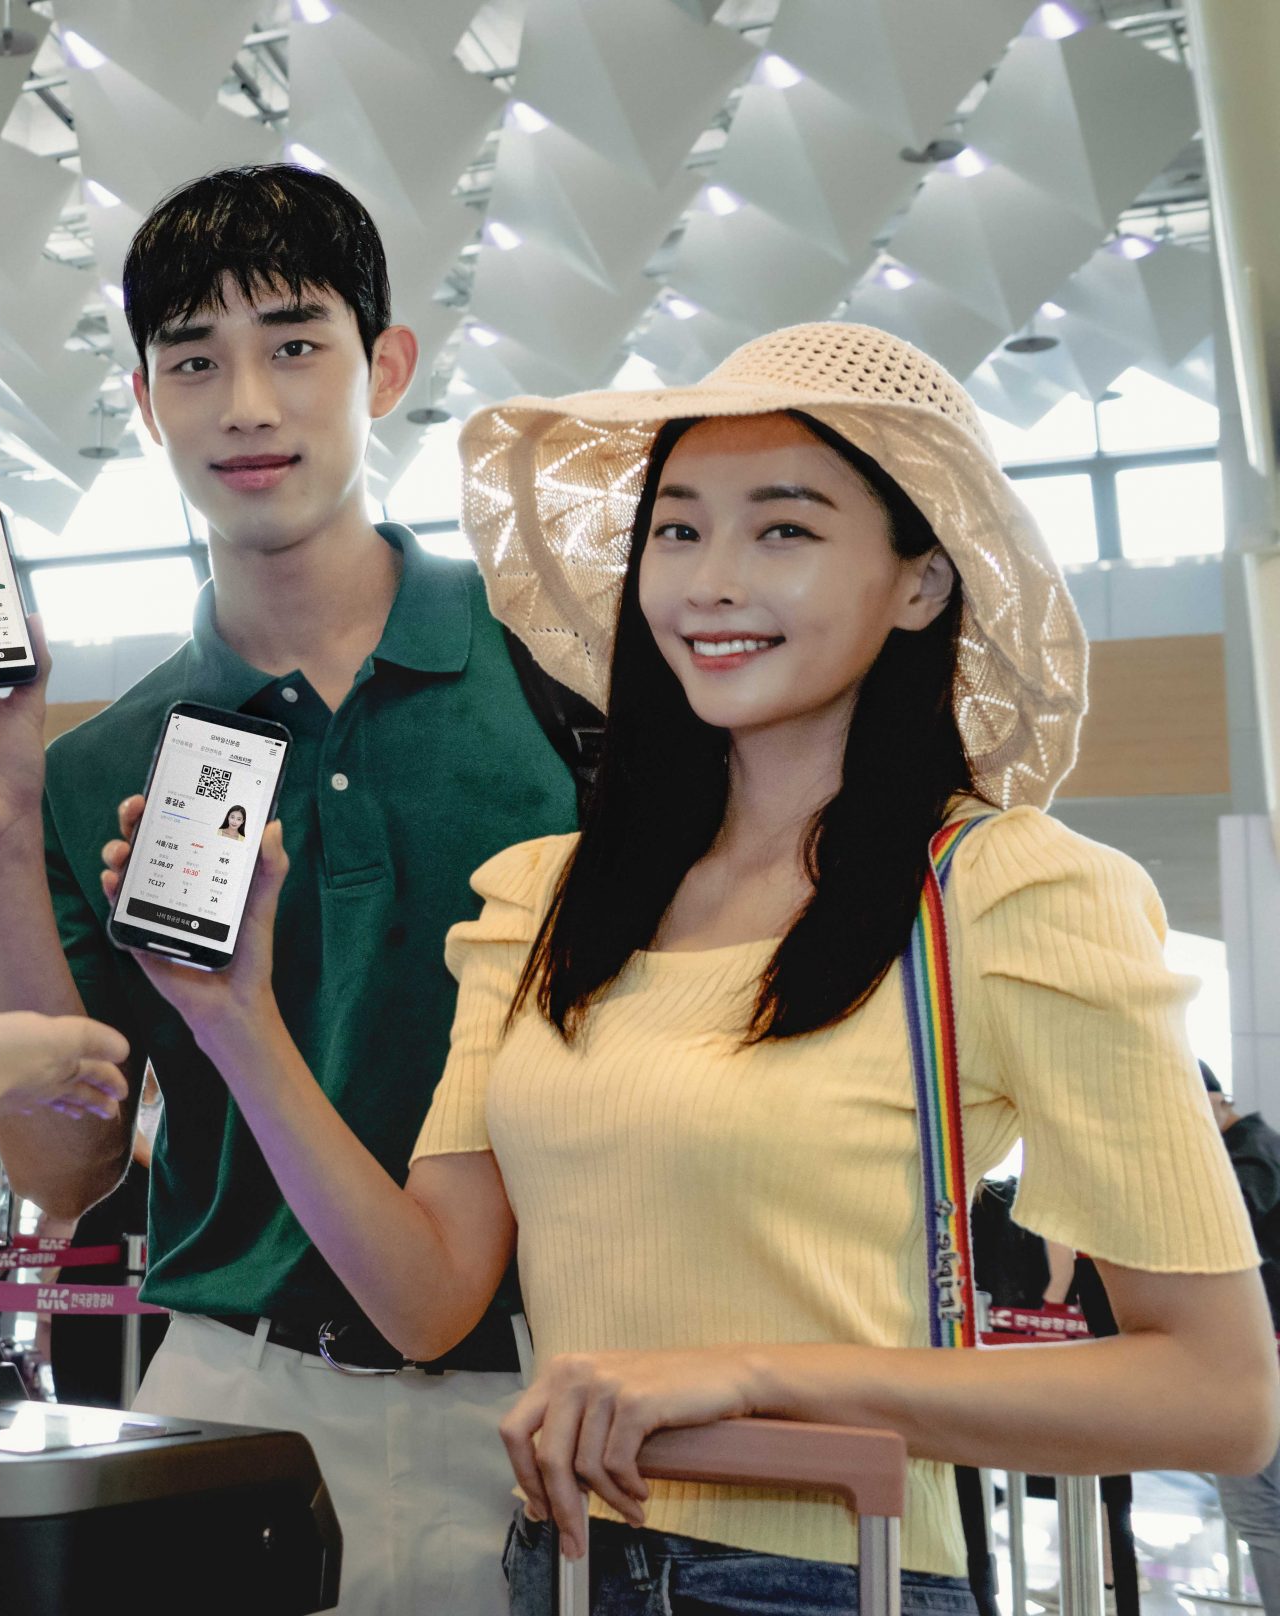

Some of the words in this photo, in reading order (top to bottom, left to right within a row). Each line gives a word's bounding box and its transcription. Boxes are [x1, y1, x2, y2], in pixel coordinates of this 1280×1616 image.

[165, 796, 186, 808] 홍길순
[148, 878, 166, 888] 7C127
[210, 896, 218, 904] 2A
[36, 1288, 70, 1311] KAC
